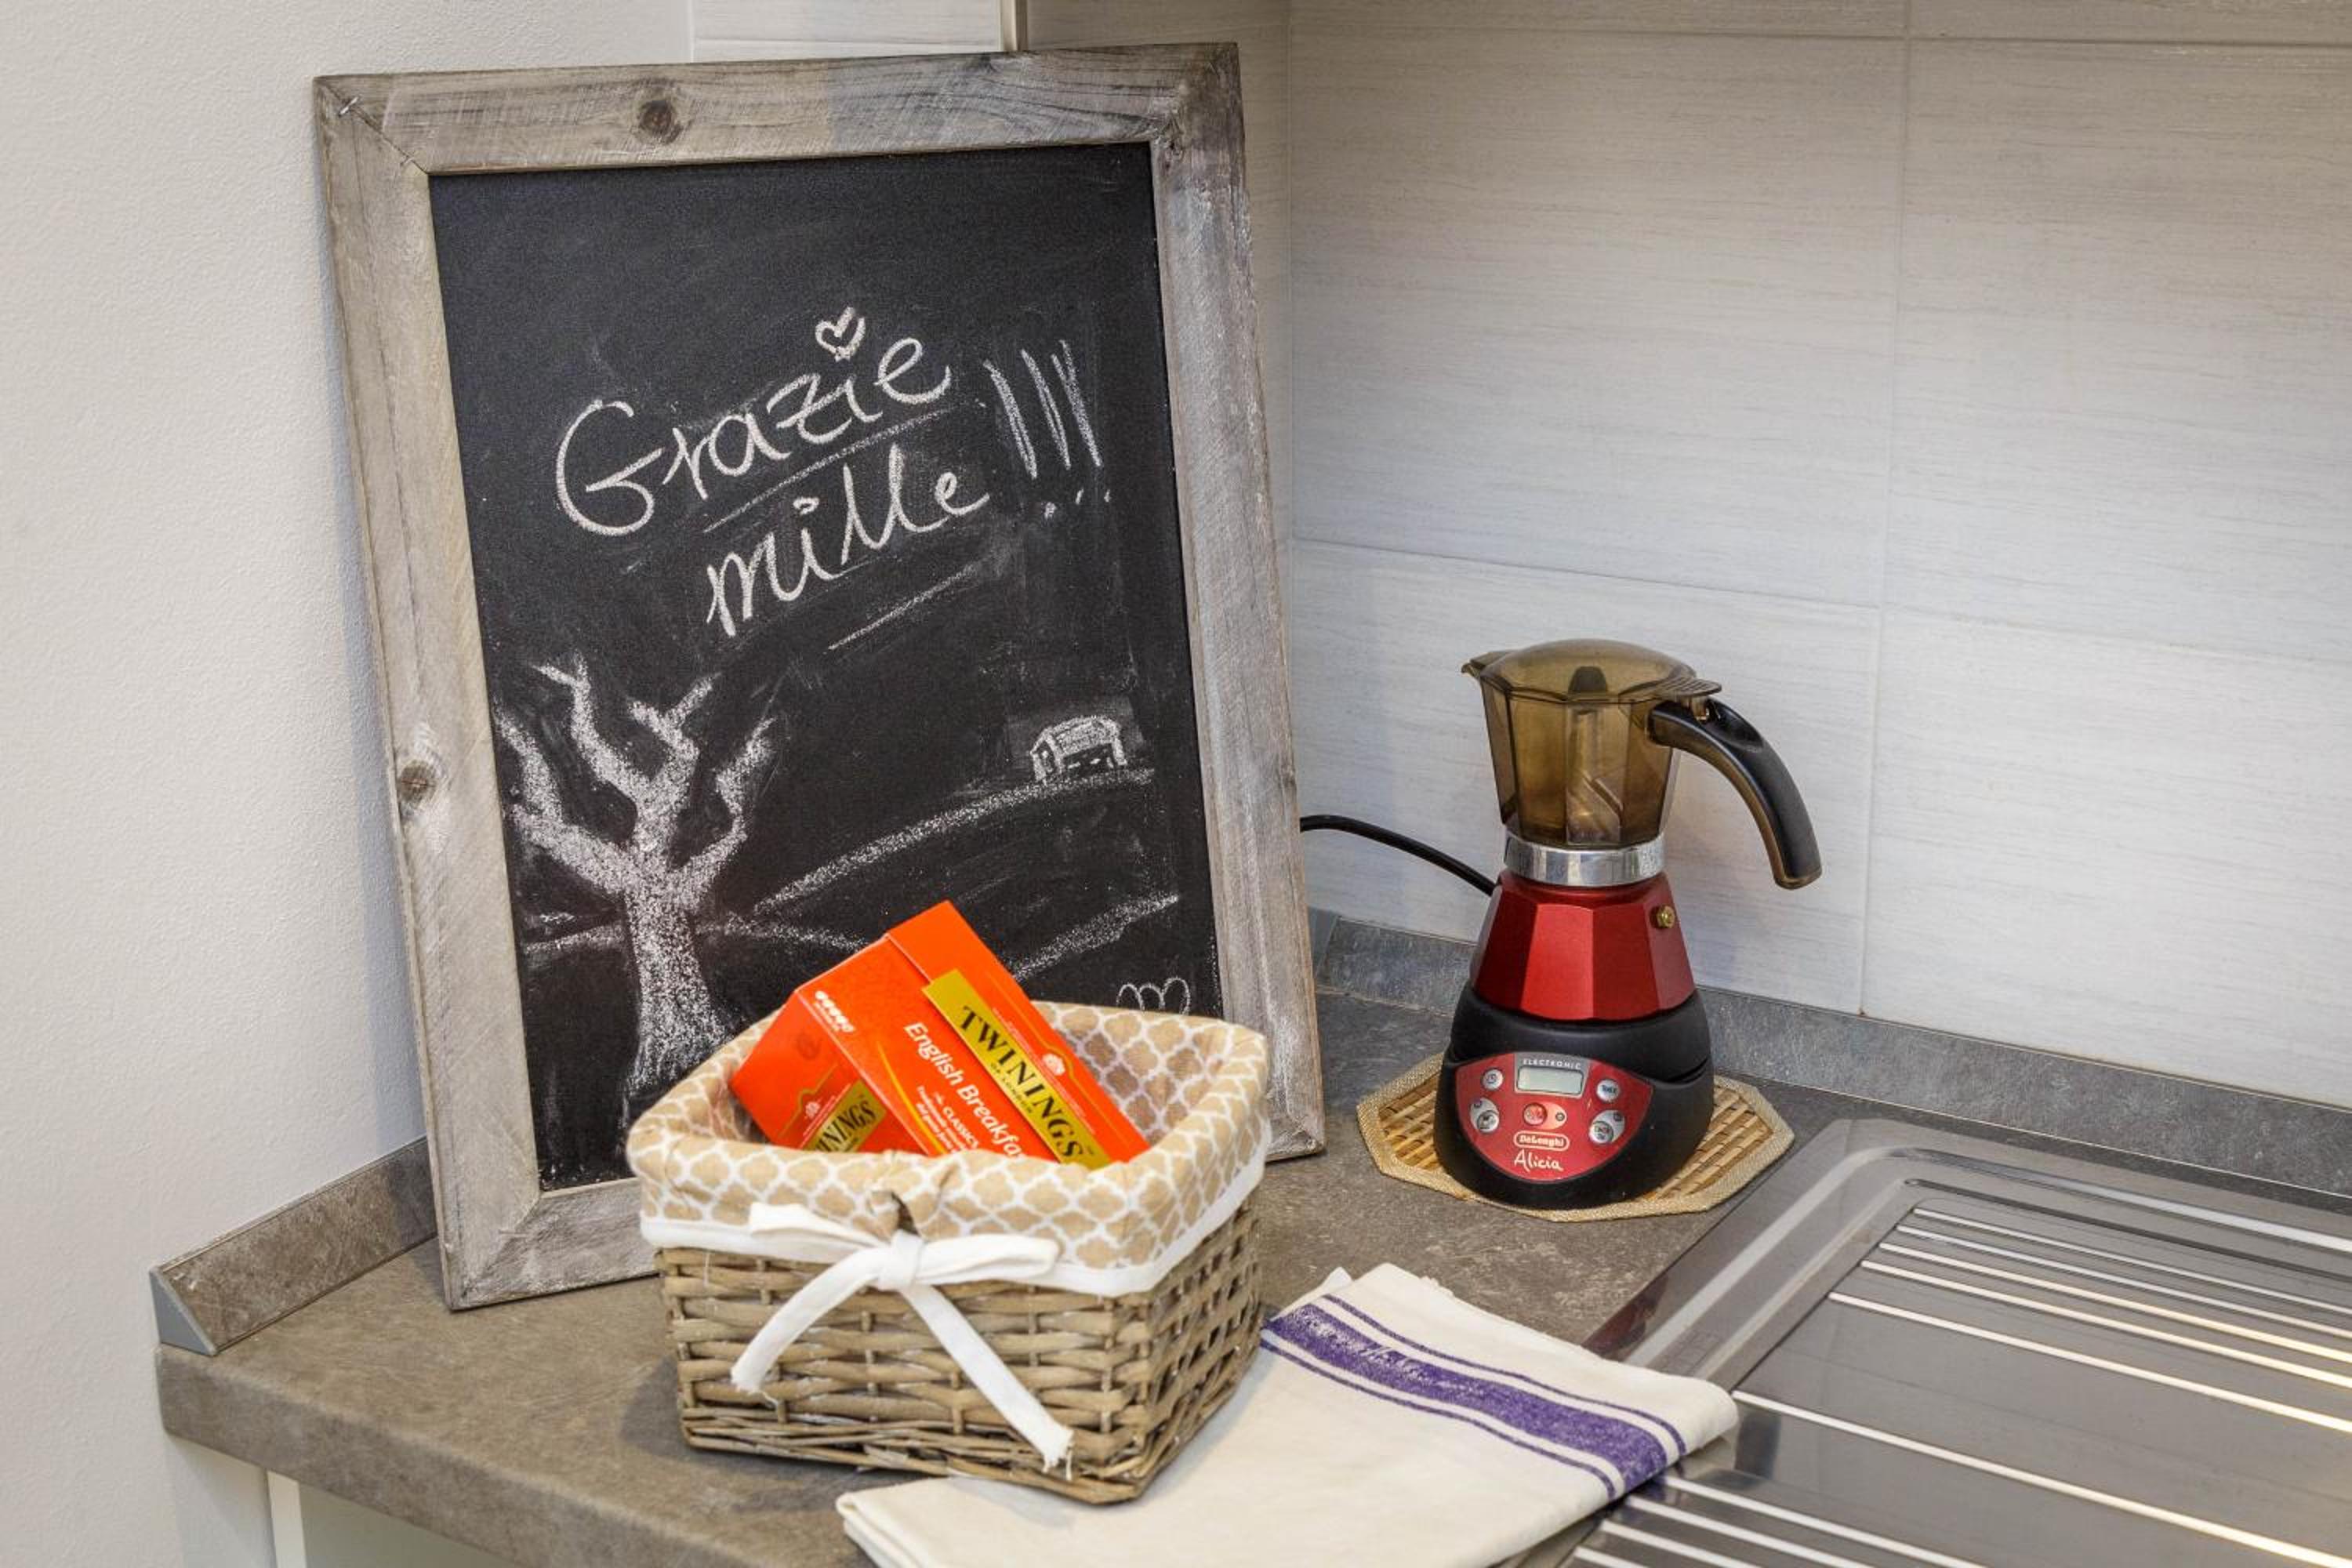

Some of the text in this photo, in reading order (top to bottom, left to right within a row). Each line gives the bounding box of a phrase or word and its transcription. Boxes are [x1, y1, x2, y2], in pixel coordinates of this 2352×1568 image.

[555, 337, 952, 535] Grazie
[706, 443, 990, 637] mille
[903, 1022, 965, 1087] English
[960, 1006, 1083, 1156] TWININGS
[1523, 1058, 1581, 1070] ELECTRONIC
[1514, 1149, 1564, 1173] Alicia
